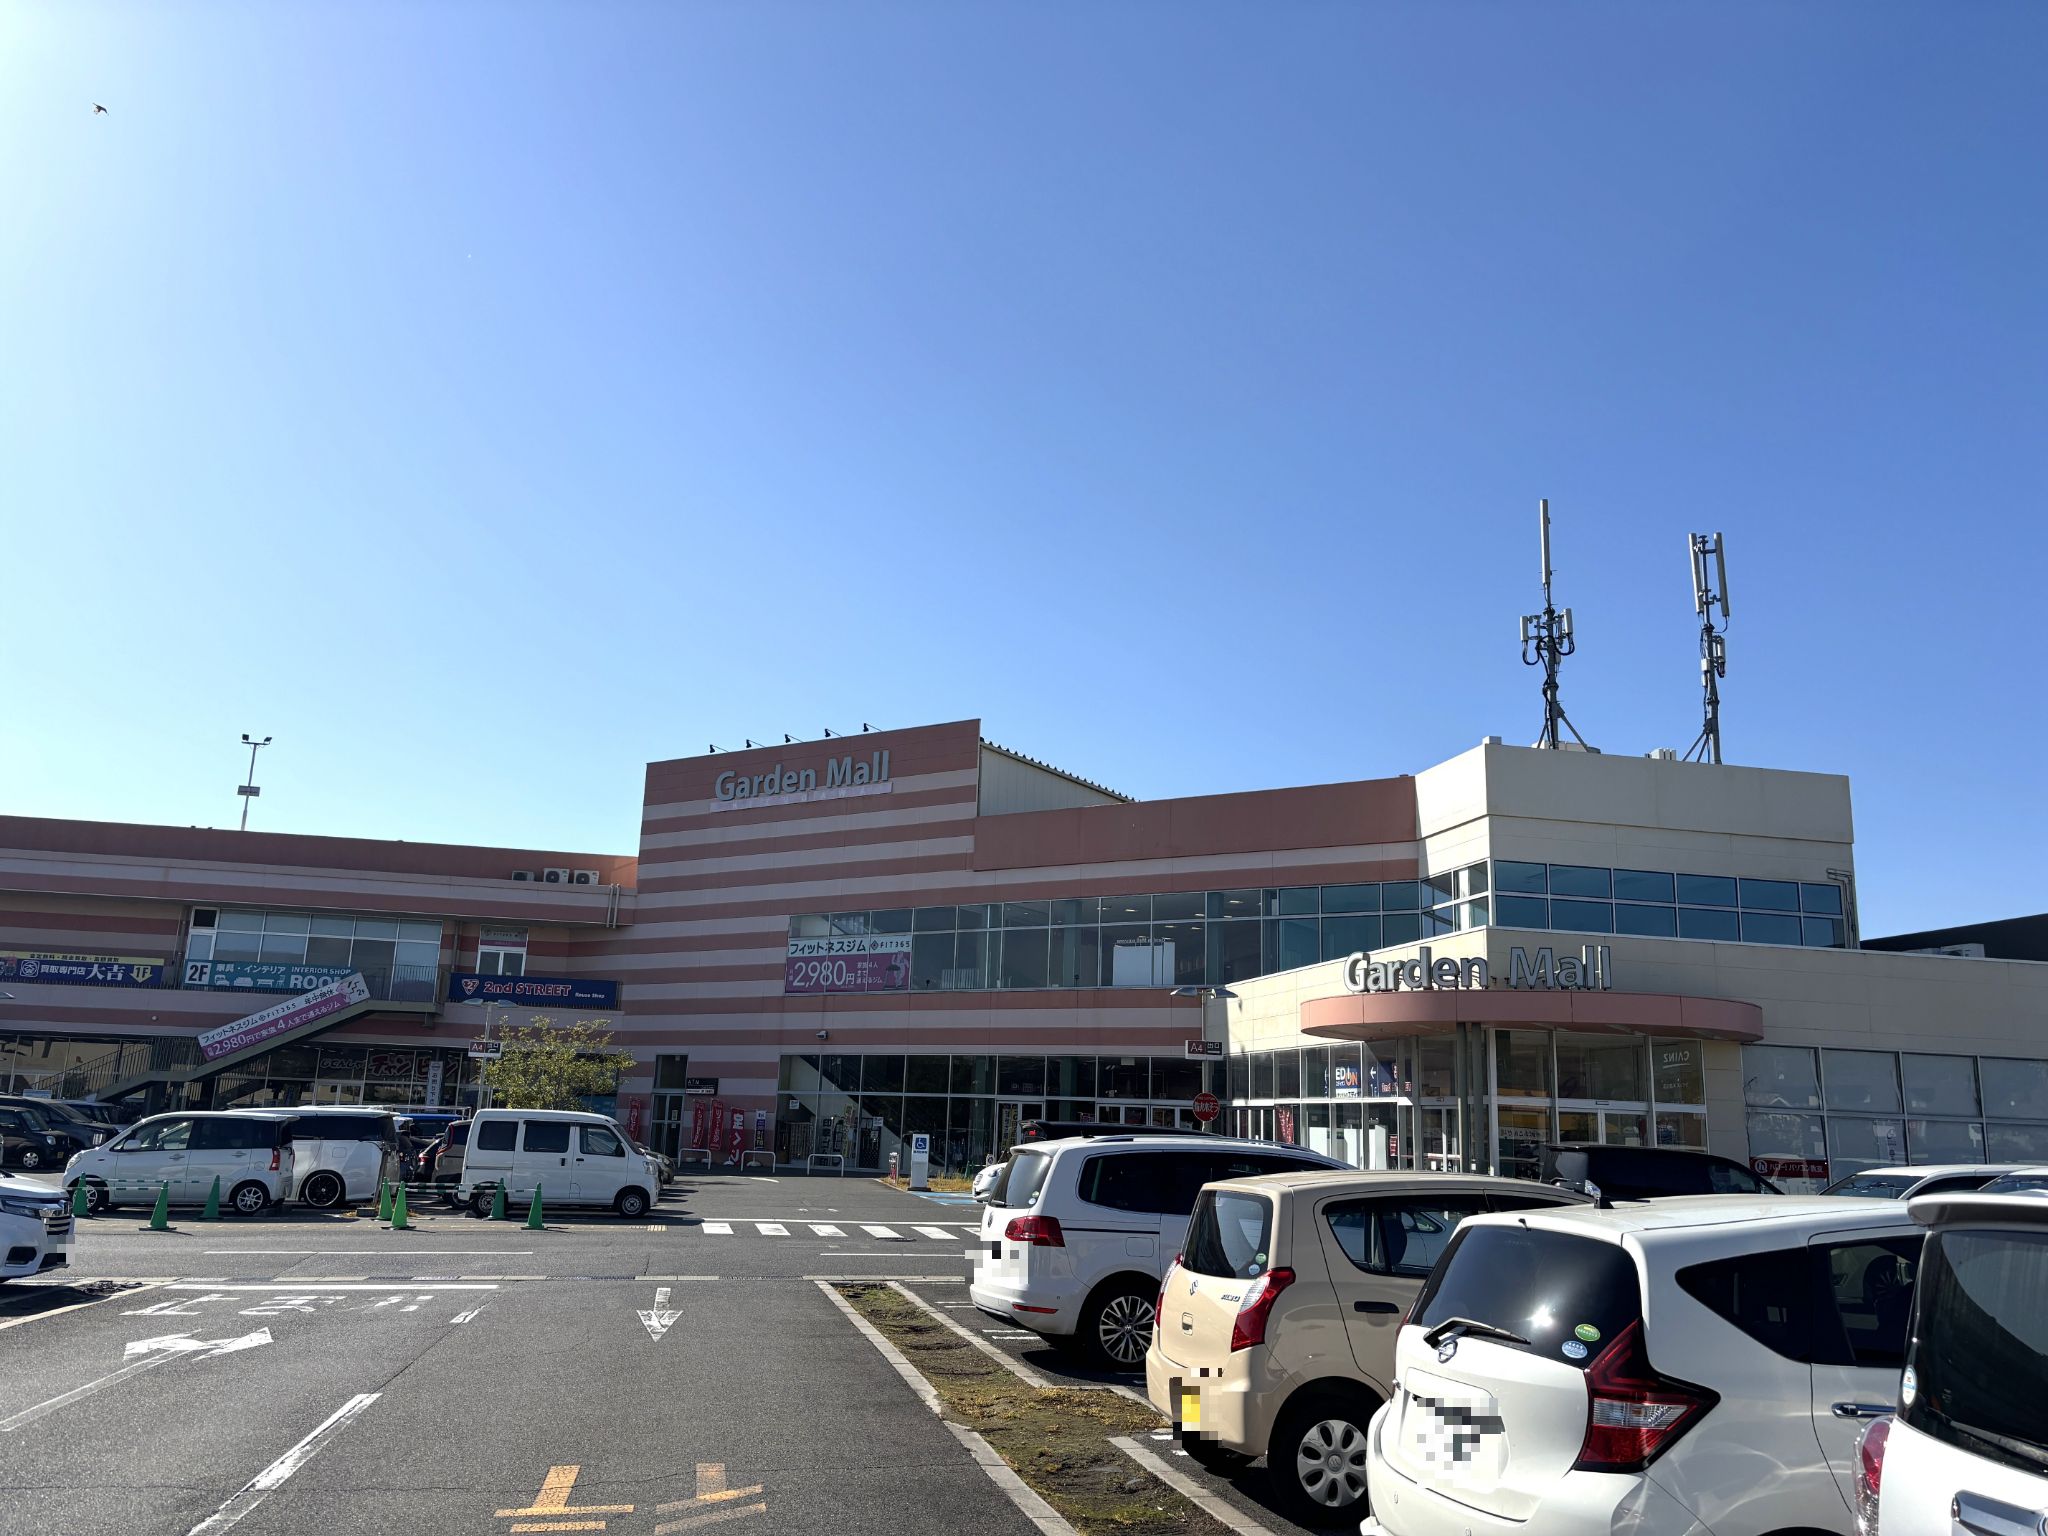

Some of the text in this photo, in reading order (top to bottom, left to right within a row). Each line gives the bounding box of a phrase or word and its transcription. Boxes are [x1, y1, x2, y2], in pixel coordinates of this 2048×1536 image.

[715, 750, 890, 802] Garden Mall
[790, 940, 866, 955] フィットネスジム
[879, 940, 911, 949] FIT365
[135, 966, 149, 979] 1F
[188, 964, 209, 982] 2F
[292, 966, 352, 979] INTERIOR SHOP
[1343, 945, 1612, 993] Garden Mall
[483, 981, 513, 994] 2nd
[515, 982, 572, 997] STREET
[202, 1019, 258, 1044] フィットネスジム
[472, 1043, 483, 1052] A4
[1190, 1043, 1203, 1052] A4
